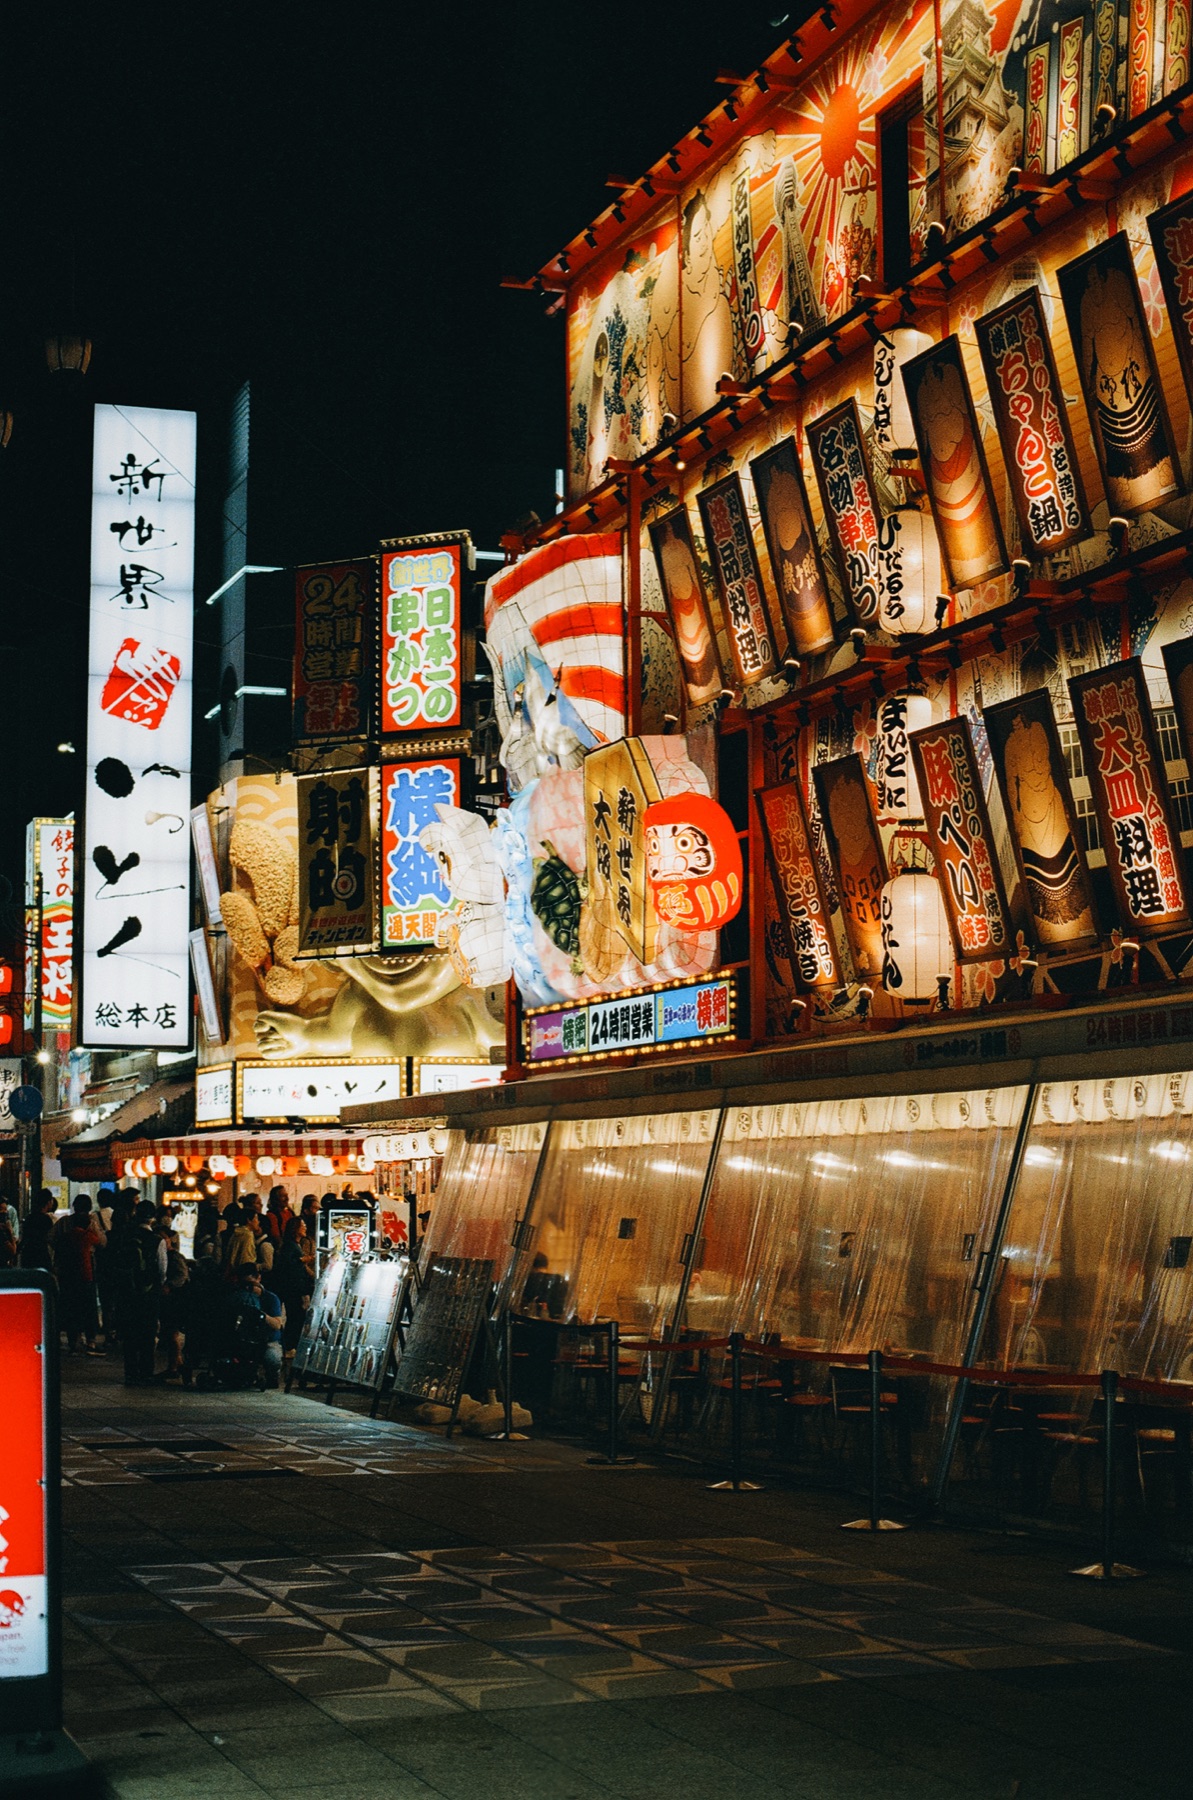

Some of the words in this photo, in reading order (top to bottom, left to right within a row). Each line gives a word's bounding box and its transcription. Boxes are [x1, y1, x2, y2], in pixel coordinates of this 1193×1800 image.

[989, 316, 1021, 358] 横綱
[996, 352, 1063, 545] ちゃんこ鍋
[1019, 306, 1081, 529] 不動の人気を誇る
[109, 453, 178, 611] 新世界
[390, 554, 452, 588] 新世界
[818, 427, 878, 619] 名物串かつ
[387, 592, 421, 727] 串かつ
[424, 587, 457, 723] 日本一の
[1082, 684, 1122, 723] 横綱
[50, 828, 75, 897] 餃子の
[306, 776, 366, 911] 射的
[388, 768, 455, 907] 横綱
[617, 787, 637, 928] 新世界
[950, 733, 1004, 946] なにわの鉄板焼き
[1097, 720, 1166, 919] 大皿料理
[41, 920, 73, 1002] 王将
[307, 926, 368, 945] チャンピオン
[388, 912, 449, 940] 通天閣
[95, 1001, 178, 1030] 総本店
[562, 1011, 587, 1051] 横綱
[591, 1002, 654, 1045] 24時間営業
[696, 986, 728, 1031] 横綱
